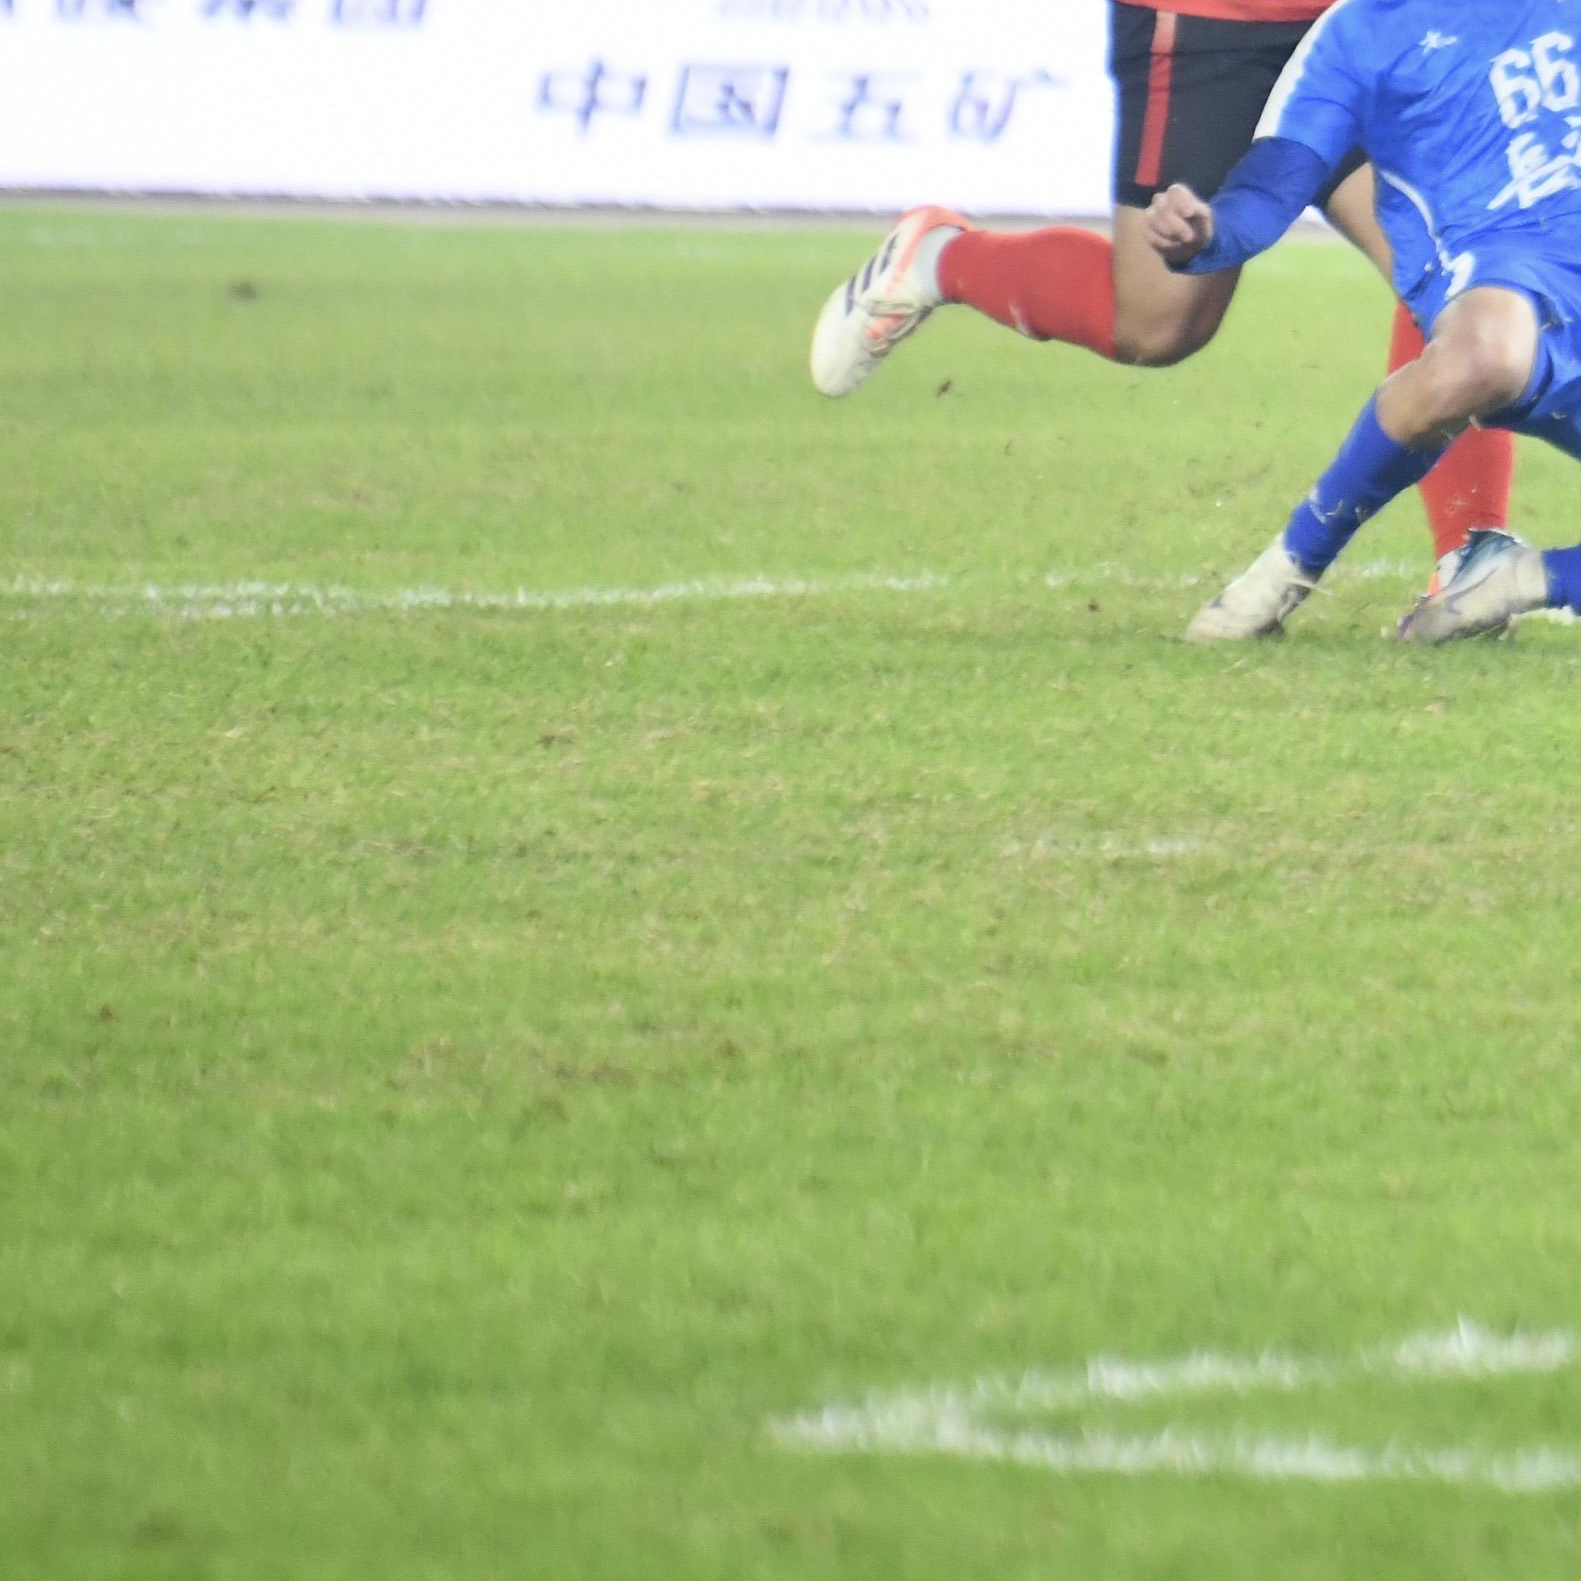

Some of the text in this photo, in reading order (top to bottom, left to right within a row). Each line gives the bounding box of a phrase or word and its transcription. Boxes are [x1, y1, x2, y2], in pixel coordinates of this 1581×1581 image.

[535, 59, 1066, 143] 中国五矿
[1488, 31, 1581, 128] 66
